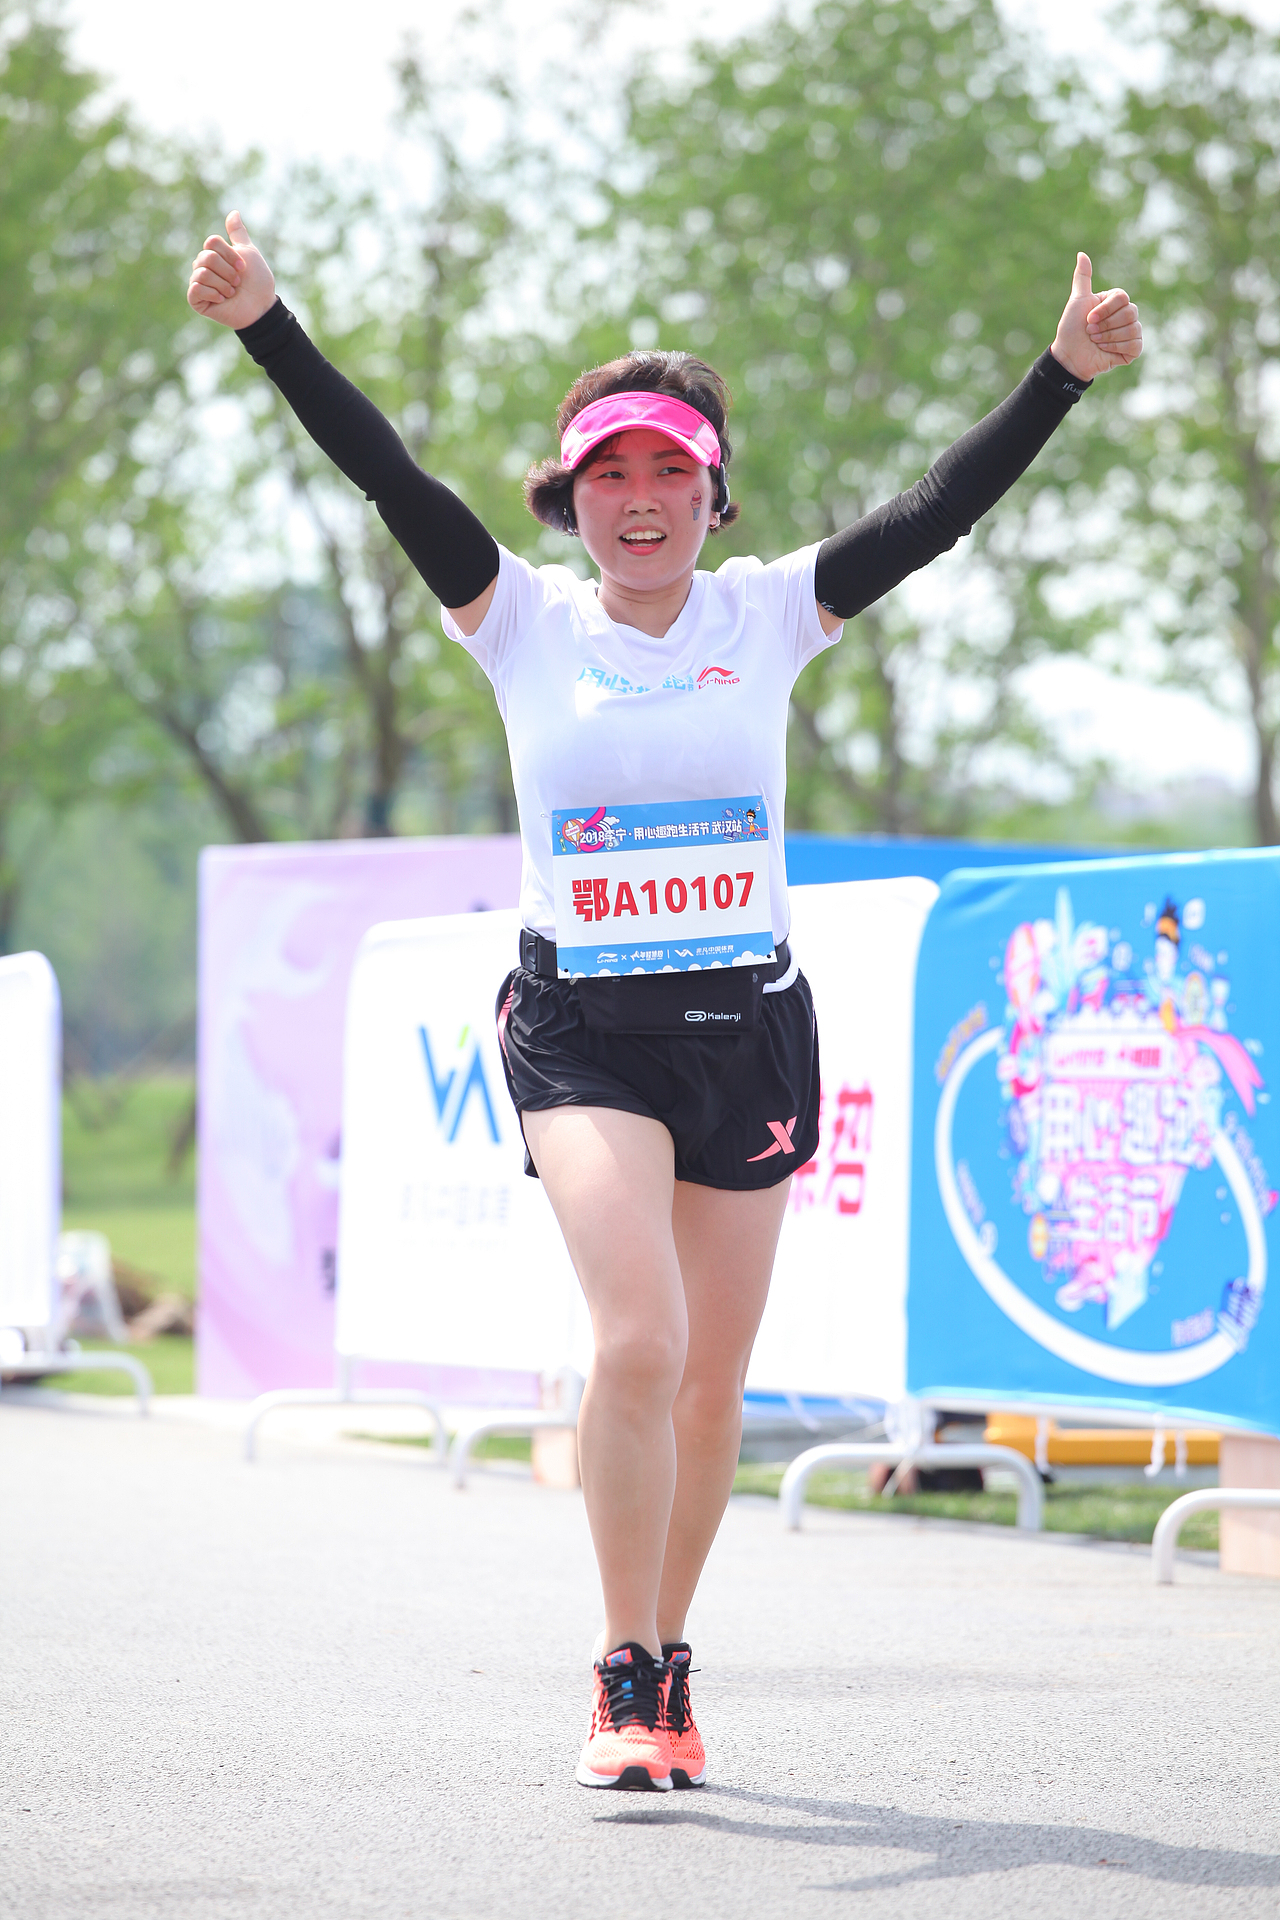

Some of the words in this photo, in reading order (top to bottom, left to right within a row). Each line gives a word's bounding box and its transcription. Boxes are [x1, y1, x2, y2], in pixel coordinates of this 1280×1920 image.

[698, 677, 740, 690] LI-NING
[711, 819, 742, 835] 武汉站
[572, 871, 754, 922] 鄂A10107
[707, 1012, 741, 1023] Kalenji
